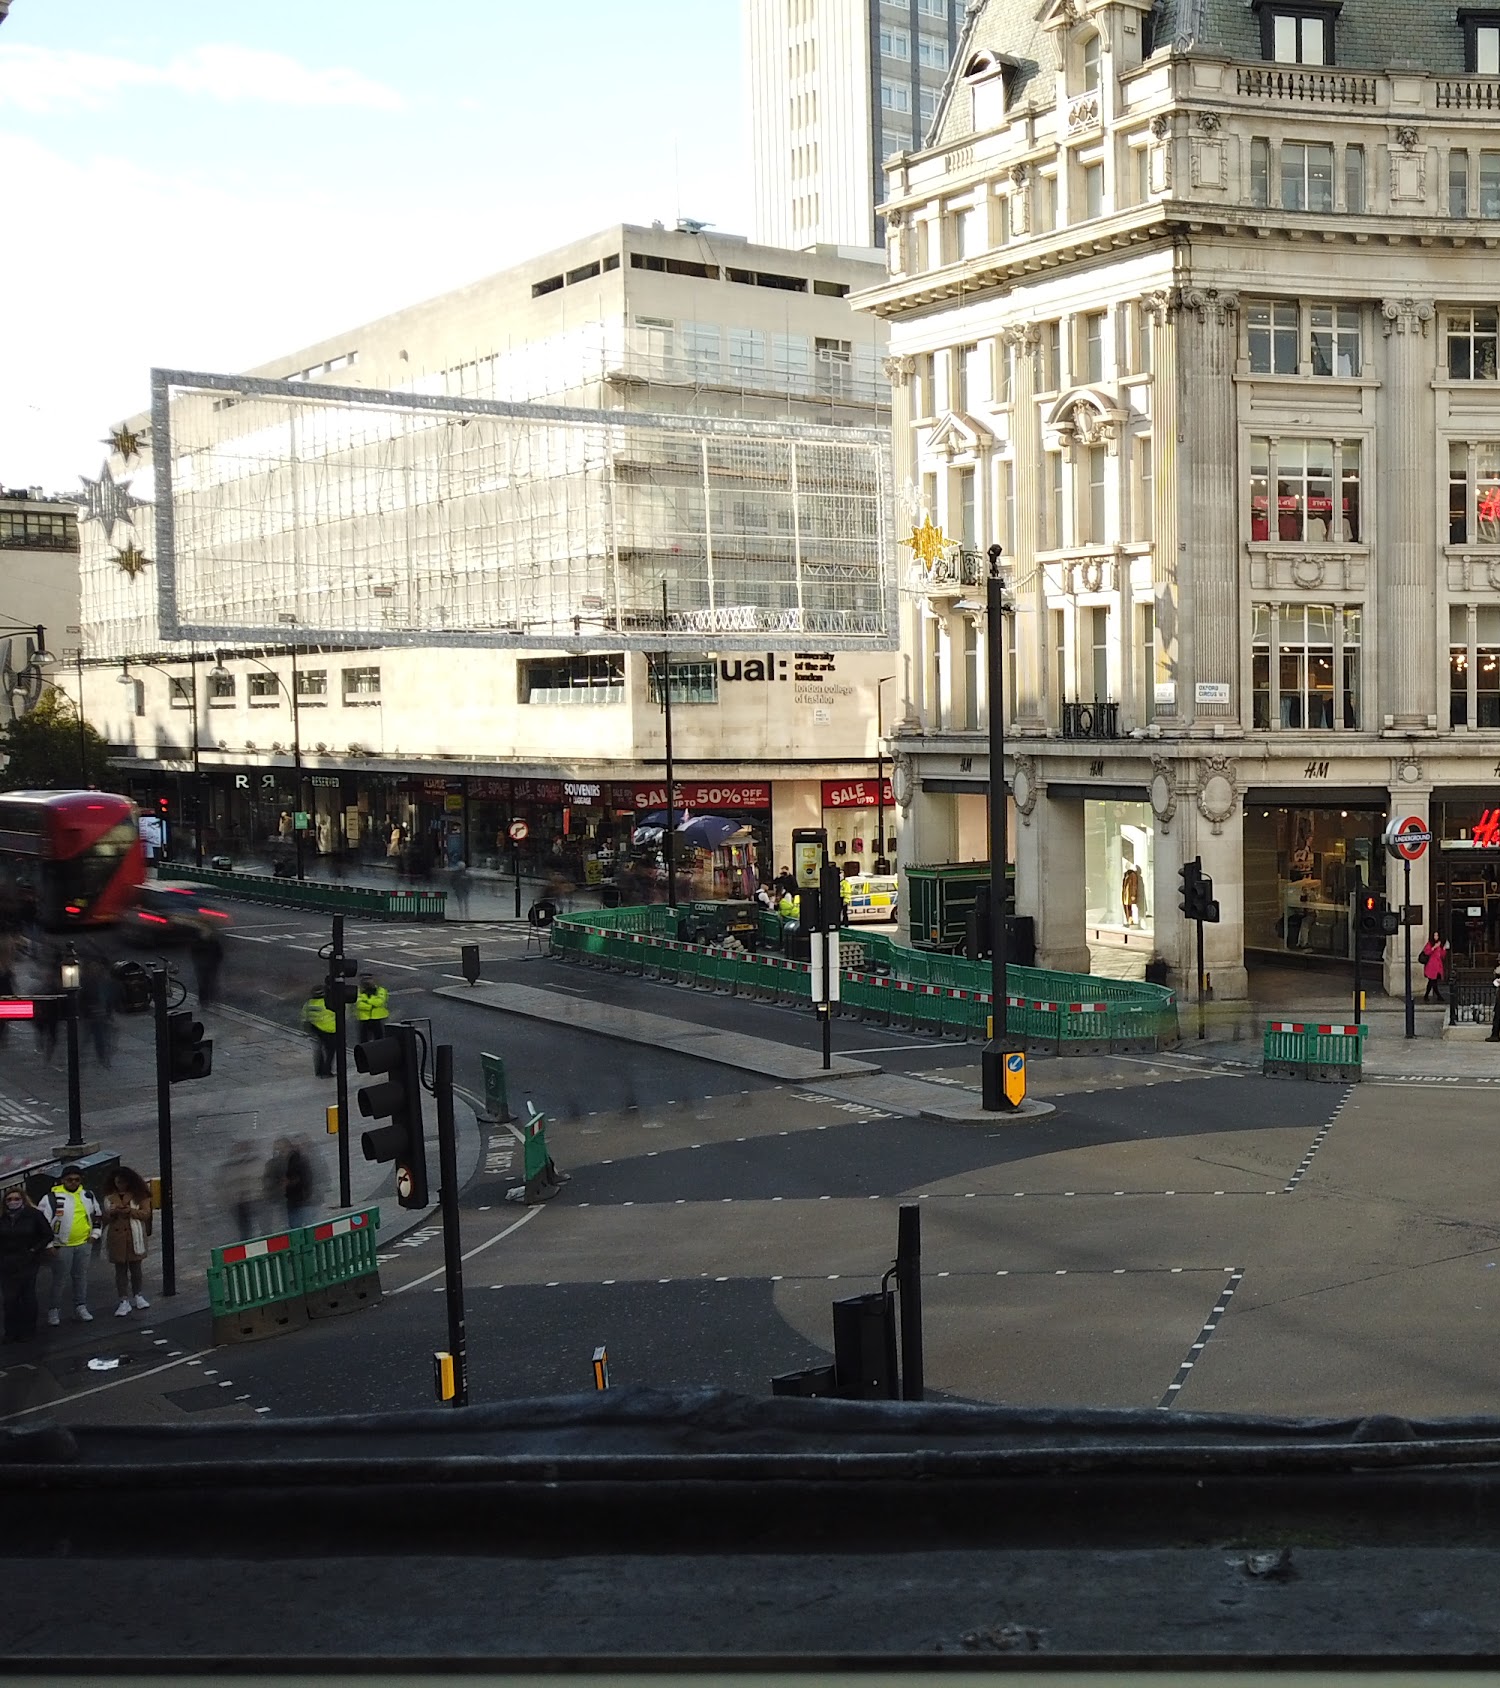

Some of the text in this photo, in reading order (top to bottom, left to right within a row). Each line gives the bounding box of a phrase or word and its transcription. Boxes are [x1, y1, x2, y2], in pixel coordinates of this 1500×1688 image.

[721, 652, 787, 681] ual:
[794, 662, 836, 672] of the arts
[794, 672, 824, 682] london
[794, 683, 853, 696] london college
[1304, 761, 1329, 779] H&M
[235, 774, 249, 789] R
[312, 775, 340, 788] RESERVED
[564, 782, 600, 797] SOUVENIRS
[696, 788, 763, 804] 50% OFF
[831, 783, 866, 805] SALE
[636, 788, 684, 809] SALE
[1394, 834, 1431, 843] UNDERGROUND
[694, 903, 719, 912] CONWAY
[846, 906, 887, 915] OLICE
[1394, 1075, 1459, 1083] RIGHT
[393, 1226, 444, 1248] LOOK
